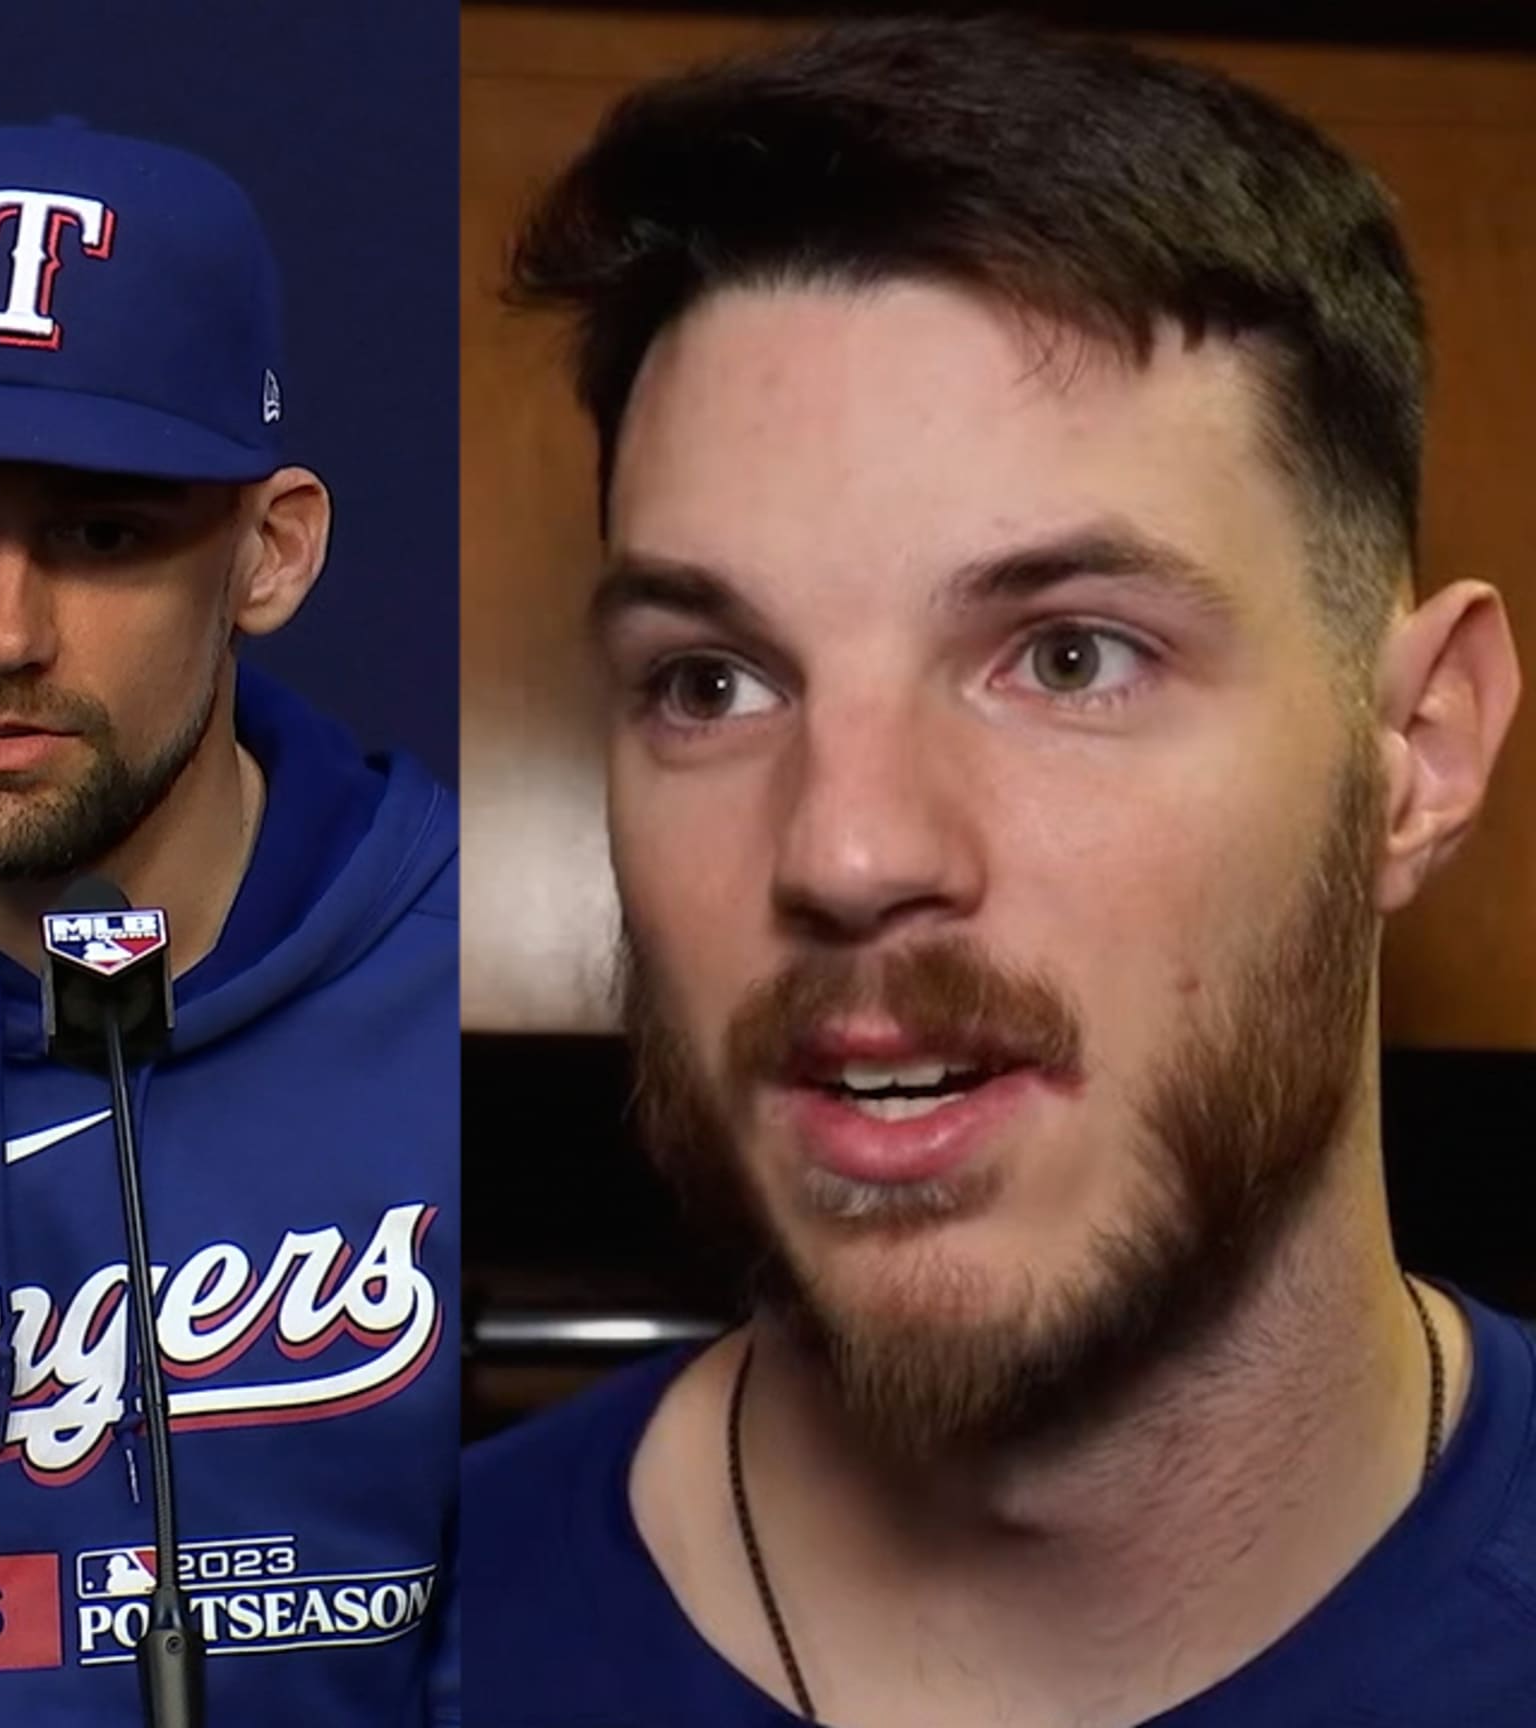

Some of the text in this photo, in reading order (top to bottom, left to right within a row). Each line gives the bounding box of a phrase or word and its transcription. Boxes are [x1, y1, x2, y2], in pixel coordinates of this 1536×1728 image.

[52, 916, 157, 938] MLB
[177, 1546, 296, 1581] 2023
[78, 1576, 435, 1652] POTSEASON
